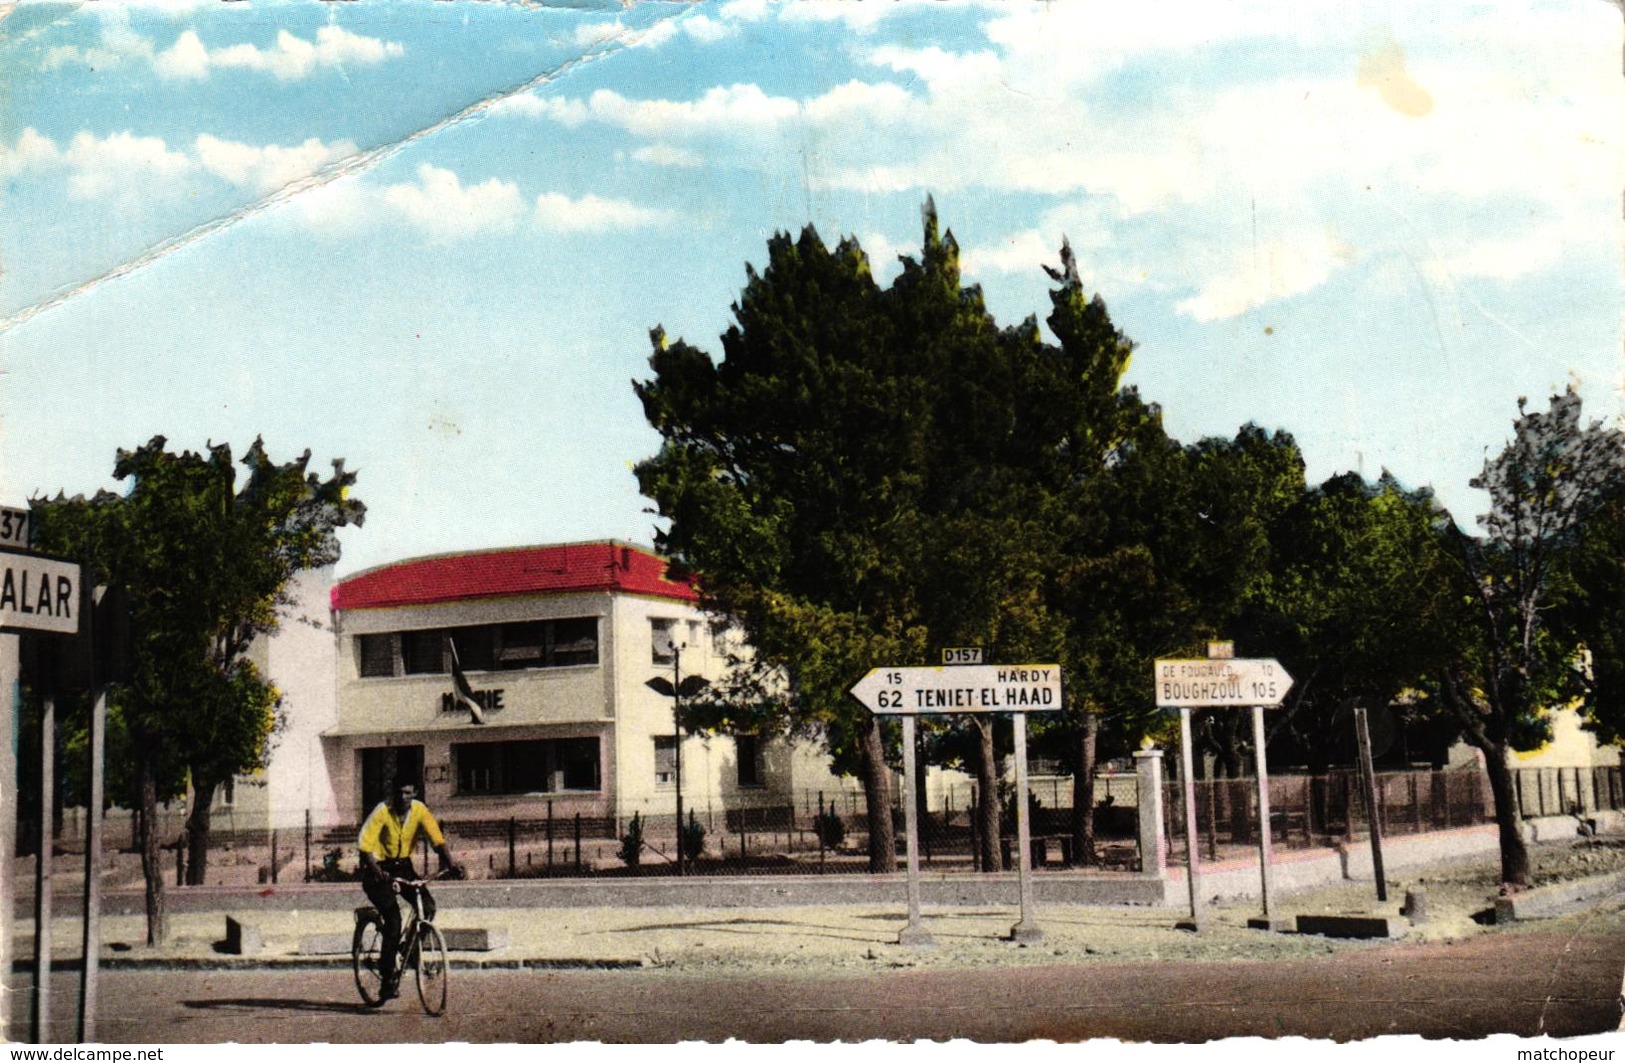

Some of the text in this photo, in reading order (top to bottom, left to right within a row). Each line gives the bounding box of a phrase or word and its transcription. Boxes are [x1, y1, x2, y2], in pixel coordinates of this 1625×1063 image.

[0, 509, 27, 541] 37
[0, 567, 72, 618] ALAR
[944, 650, 979, 662] D157
[886, 669, 1050, 685] 15 HARDY
[1163, 665, 1176, 678] DE
[1262, 664, 1273, 677] 10
[878, 690, 903, 708] 62
[1164, 682, 1277, 700] BOUGHZOUL 105
[442, 689, 505, 712] MRIE
